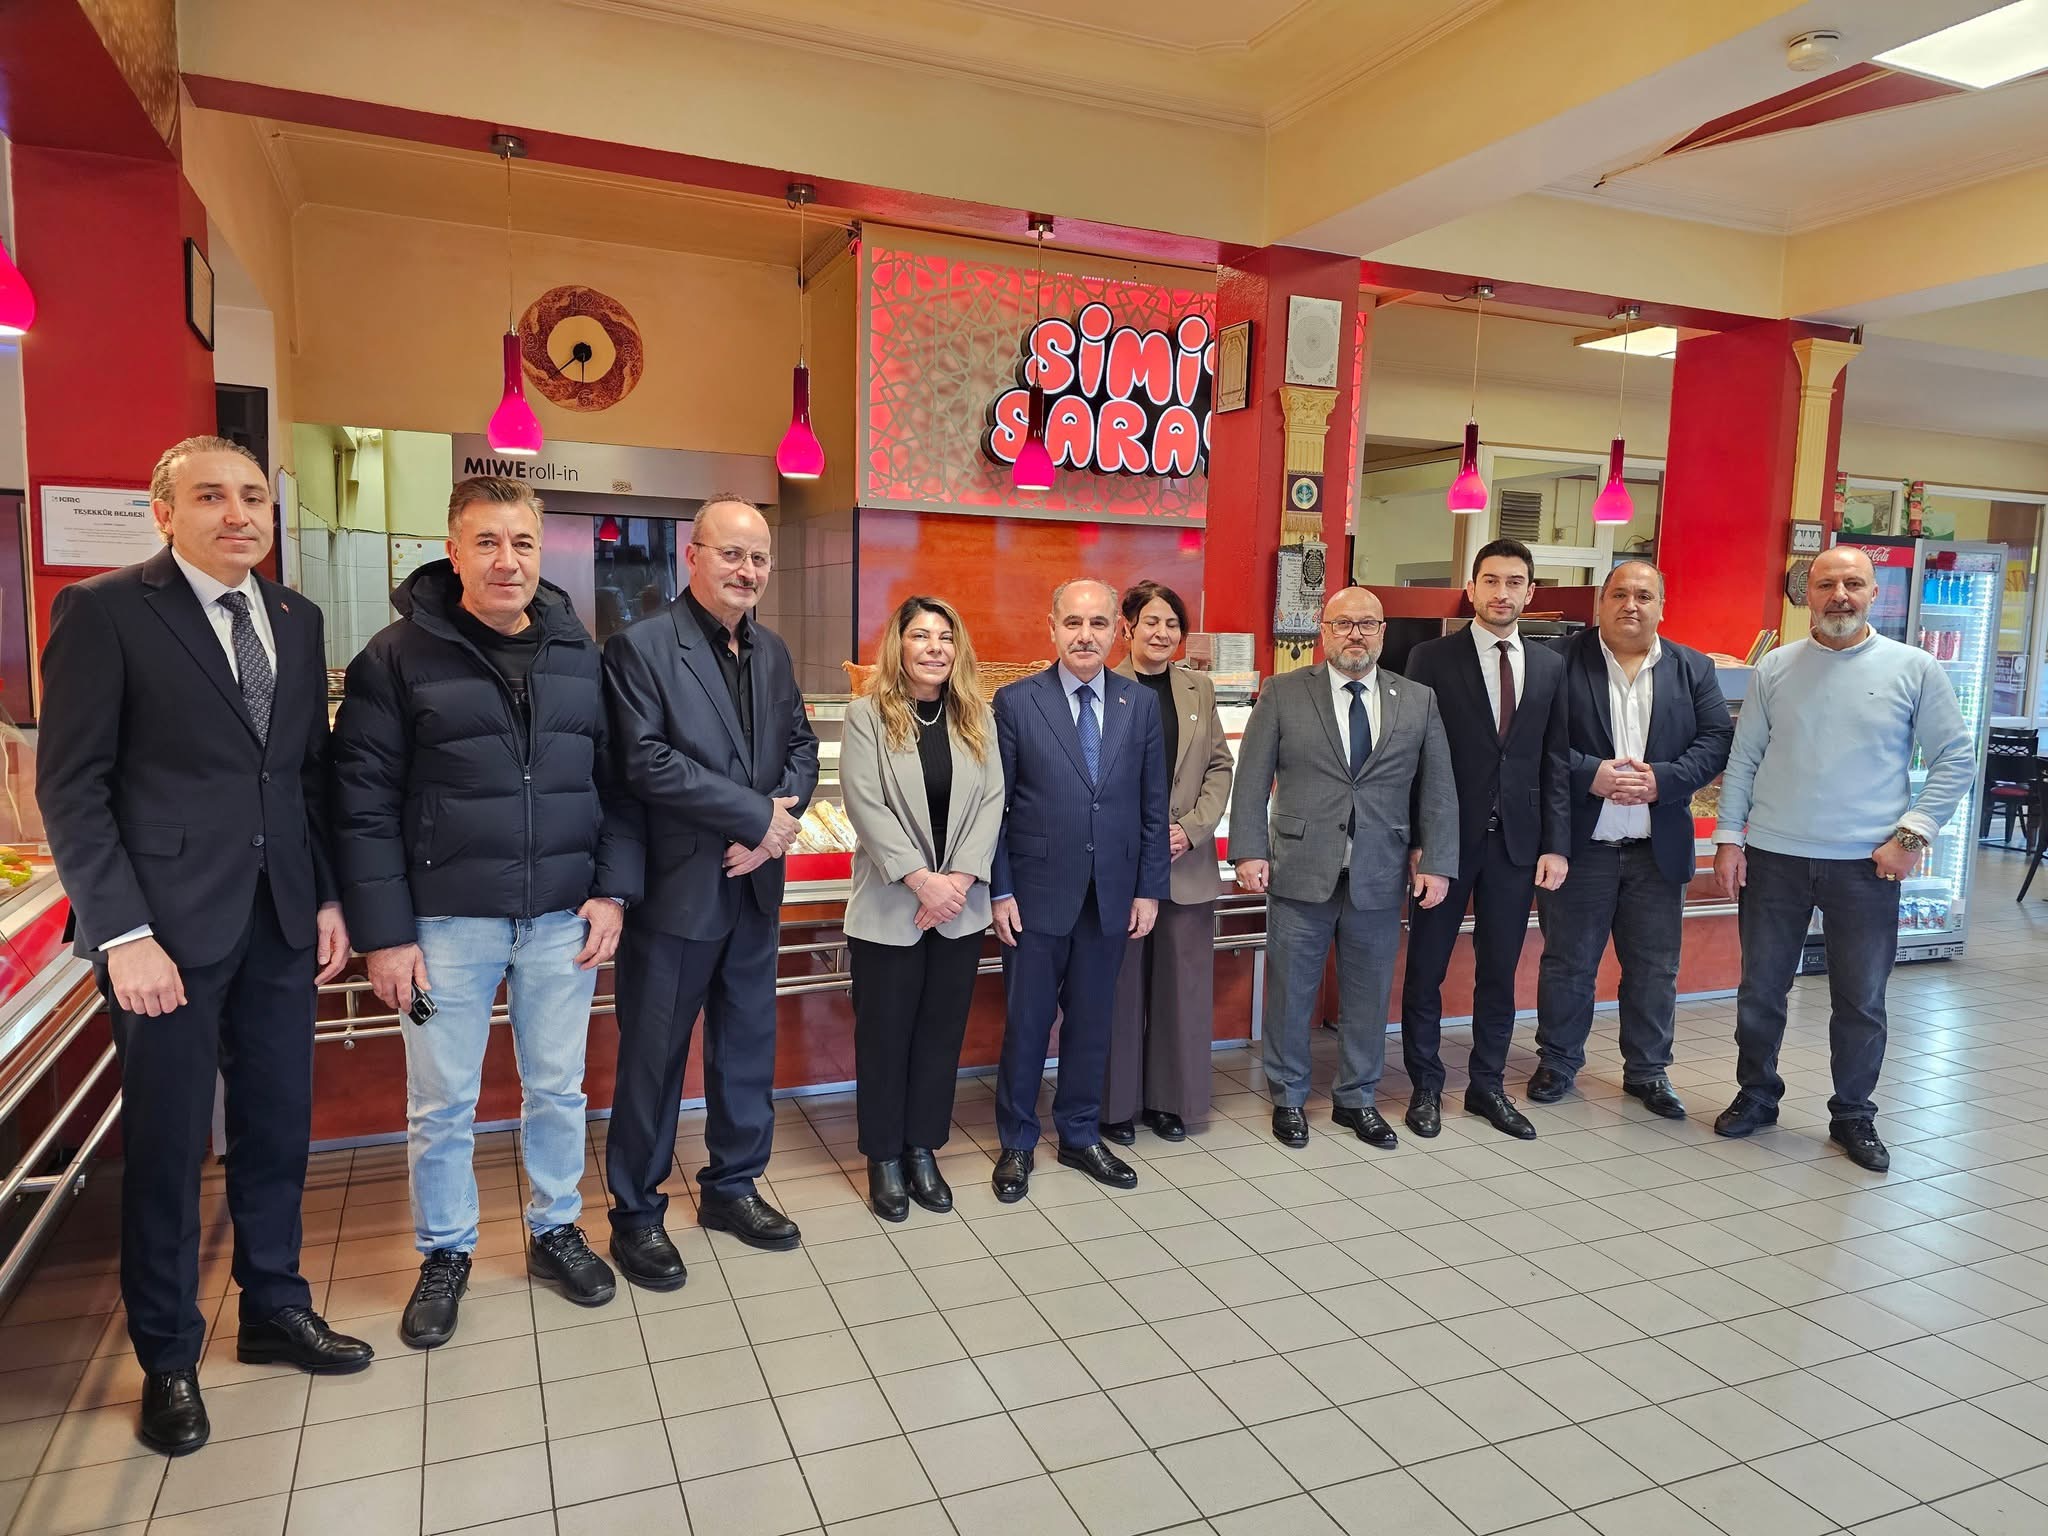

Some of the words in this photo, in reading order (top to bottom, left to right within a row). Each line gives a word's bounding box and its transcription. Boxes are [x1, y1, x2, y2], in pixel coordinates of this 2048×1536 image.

[568, 291, 594, 311] 12
[1023, 302, 1215, 408] SİMİ
[989, 388, 1212, 477] SARA
[464, 457, 527, 479] MIWE
[529, 463, 579, 482] roll-in
